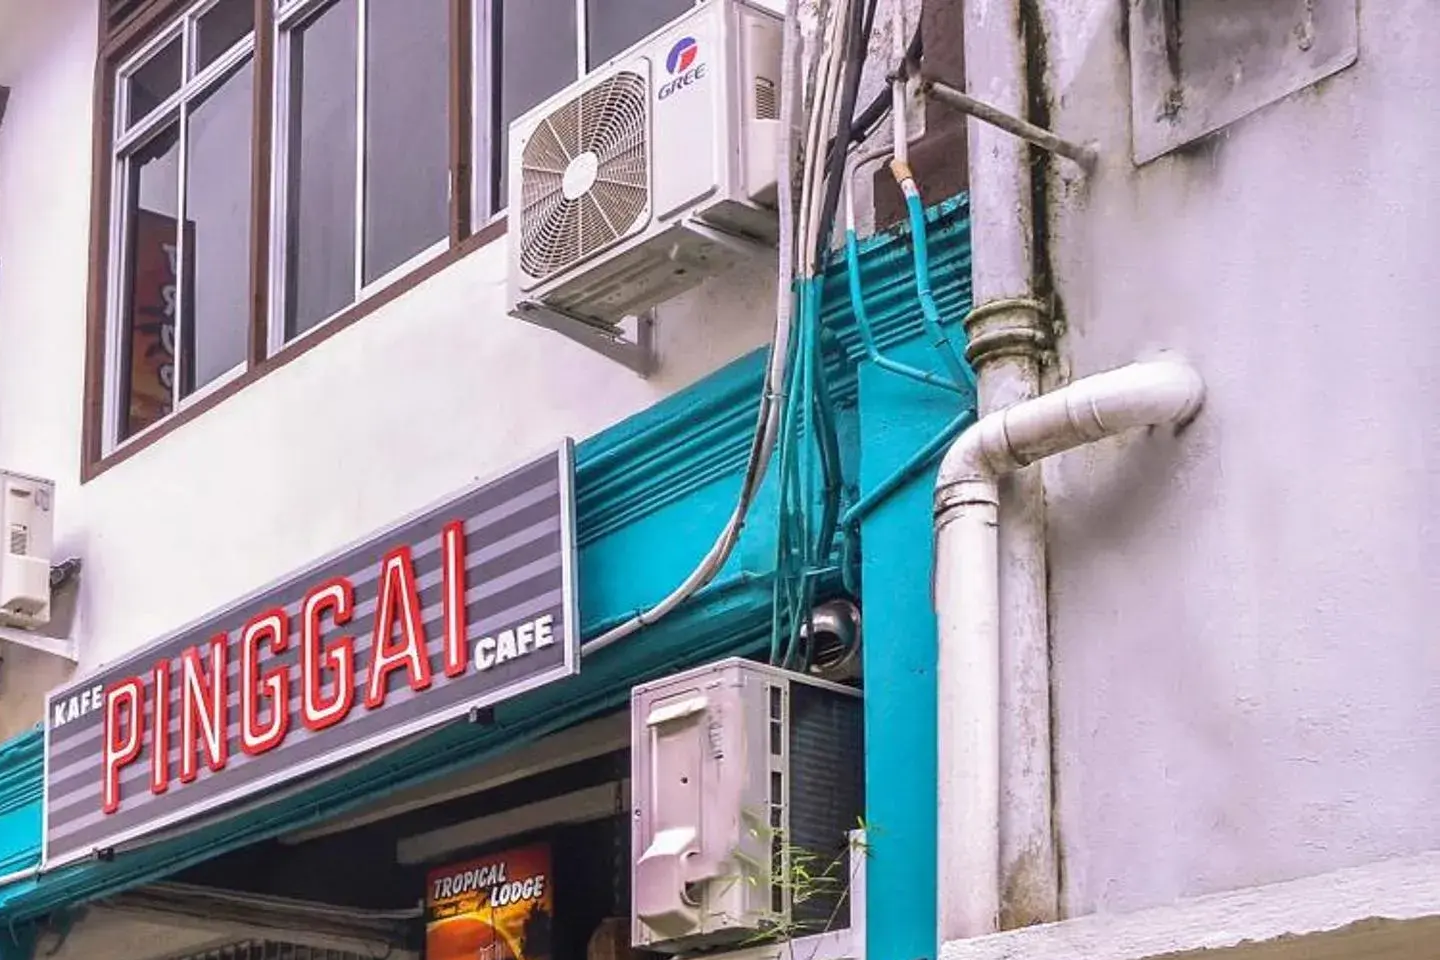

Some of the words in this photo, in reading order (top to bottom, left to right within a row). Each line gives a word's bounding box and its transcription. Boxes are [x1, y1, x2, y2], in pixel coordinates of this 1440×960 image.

[658, 63, 706, 100] GREE
[474, 615, 555, 671] CAFE
[102, 519, 468, 814] PINGGAI
[55, 685, 103, 728] KAFE
[434, 862, 507, 899] TROPICAL
[491, 875, 545, 907] LODGE
